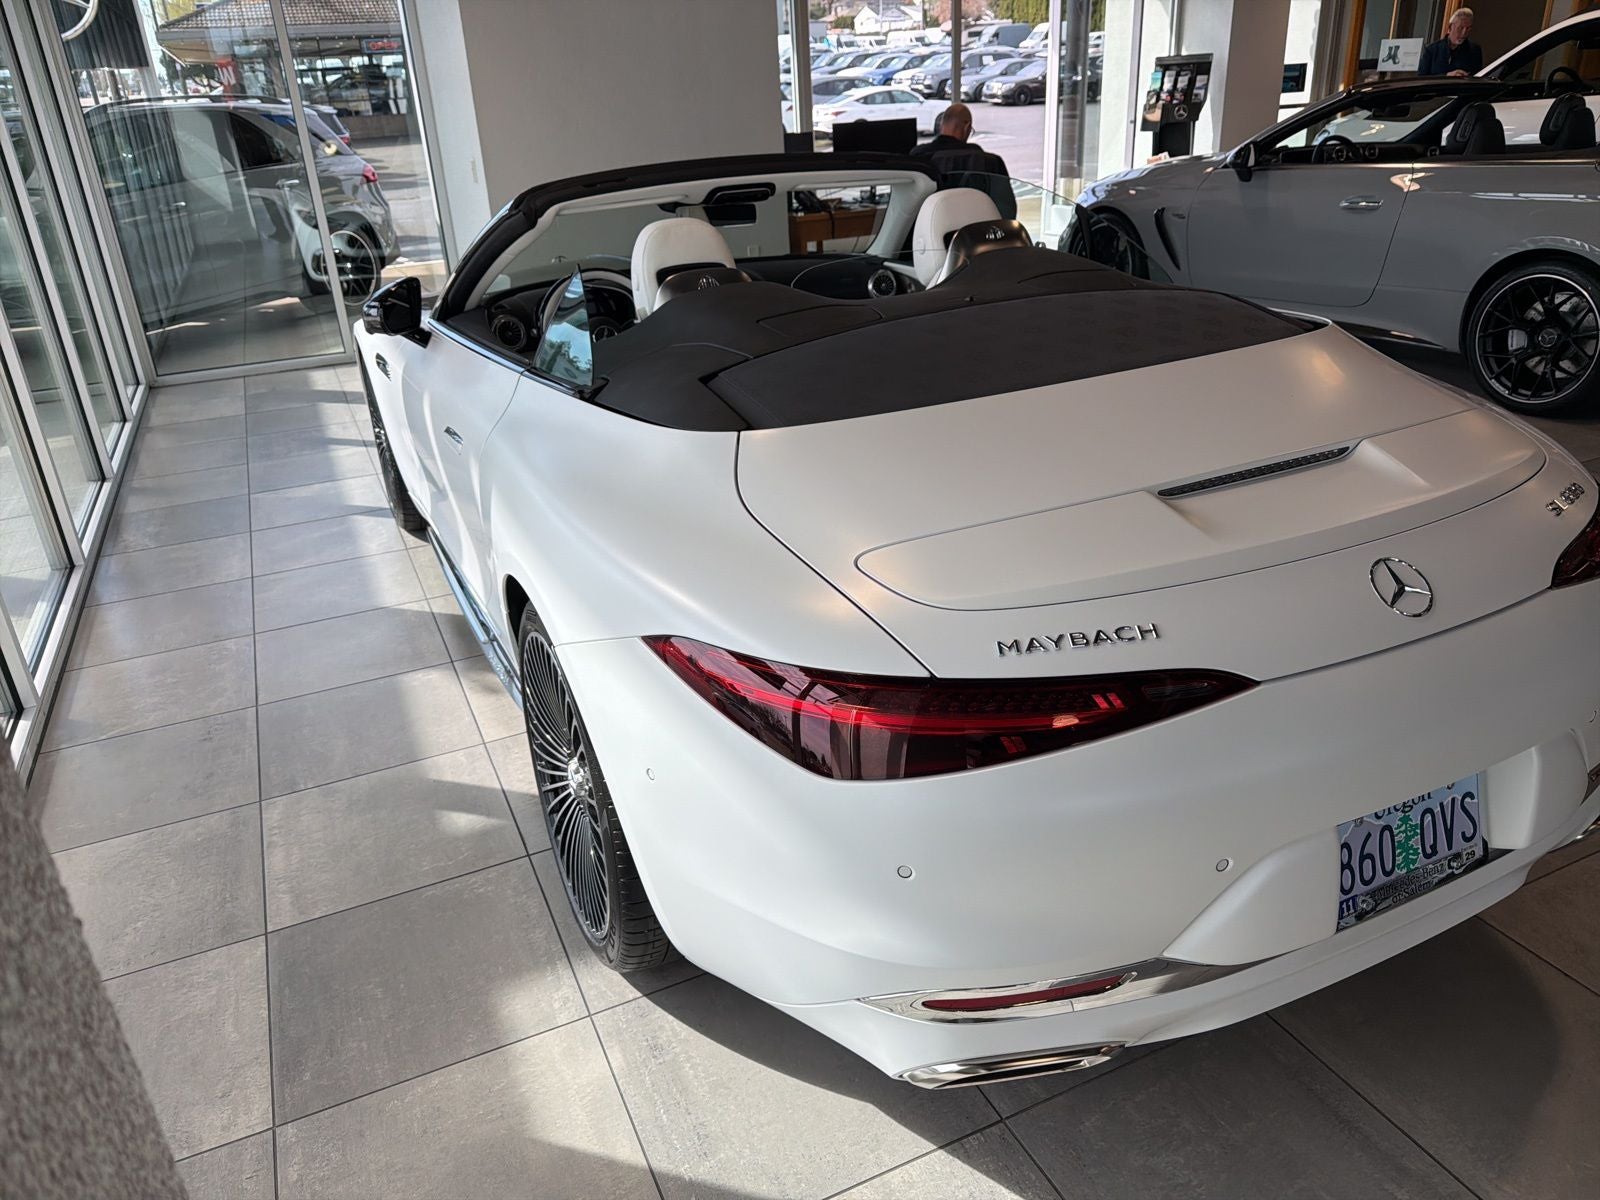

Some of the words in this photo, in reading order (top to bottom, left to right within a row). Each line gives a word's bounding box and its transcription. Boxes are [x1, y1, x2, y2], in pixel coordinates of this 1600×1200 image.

[1545, 499, 1569, 517] SL
[995, 622, 1162, 657] MAYBACH
[1339, 823, 1397, 896] 860
[1418, 790, 1479, 861] QVS
[1464, 849, 1477, 861] 29
[1402, 878, 1432, 898] Salem
[1341, 898, 1356, 917] 11
